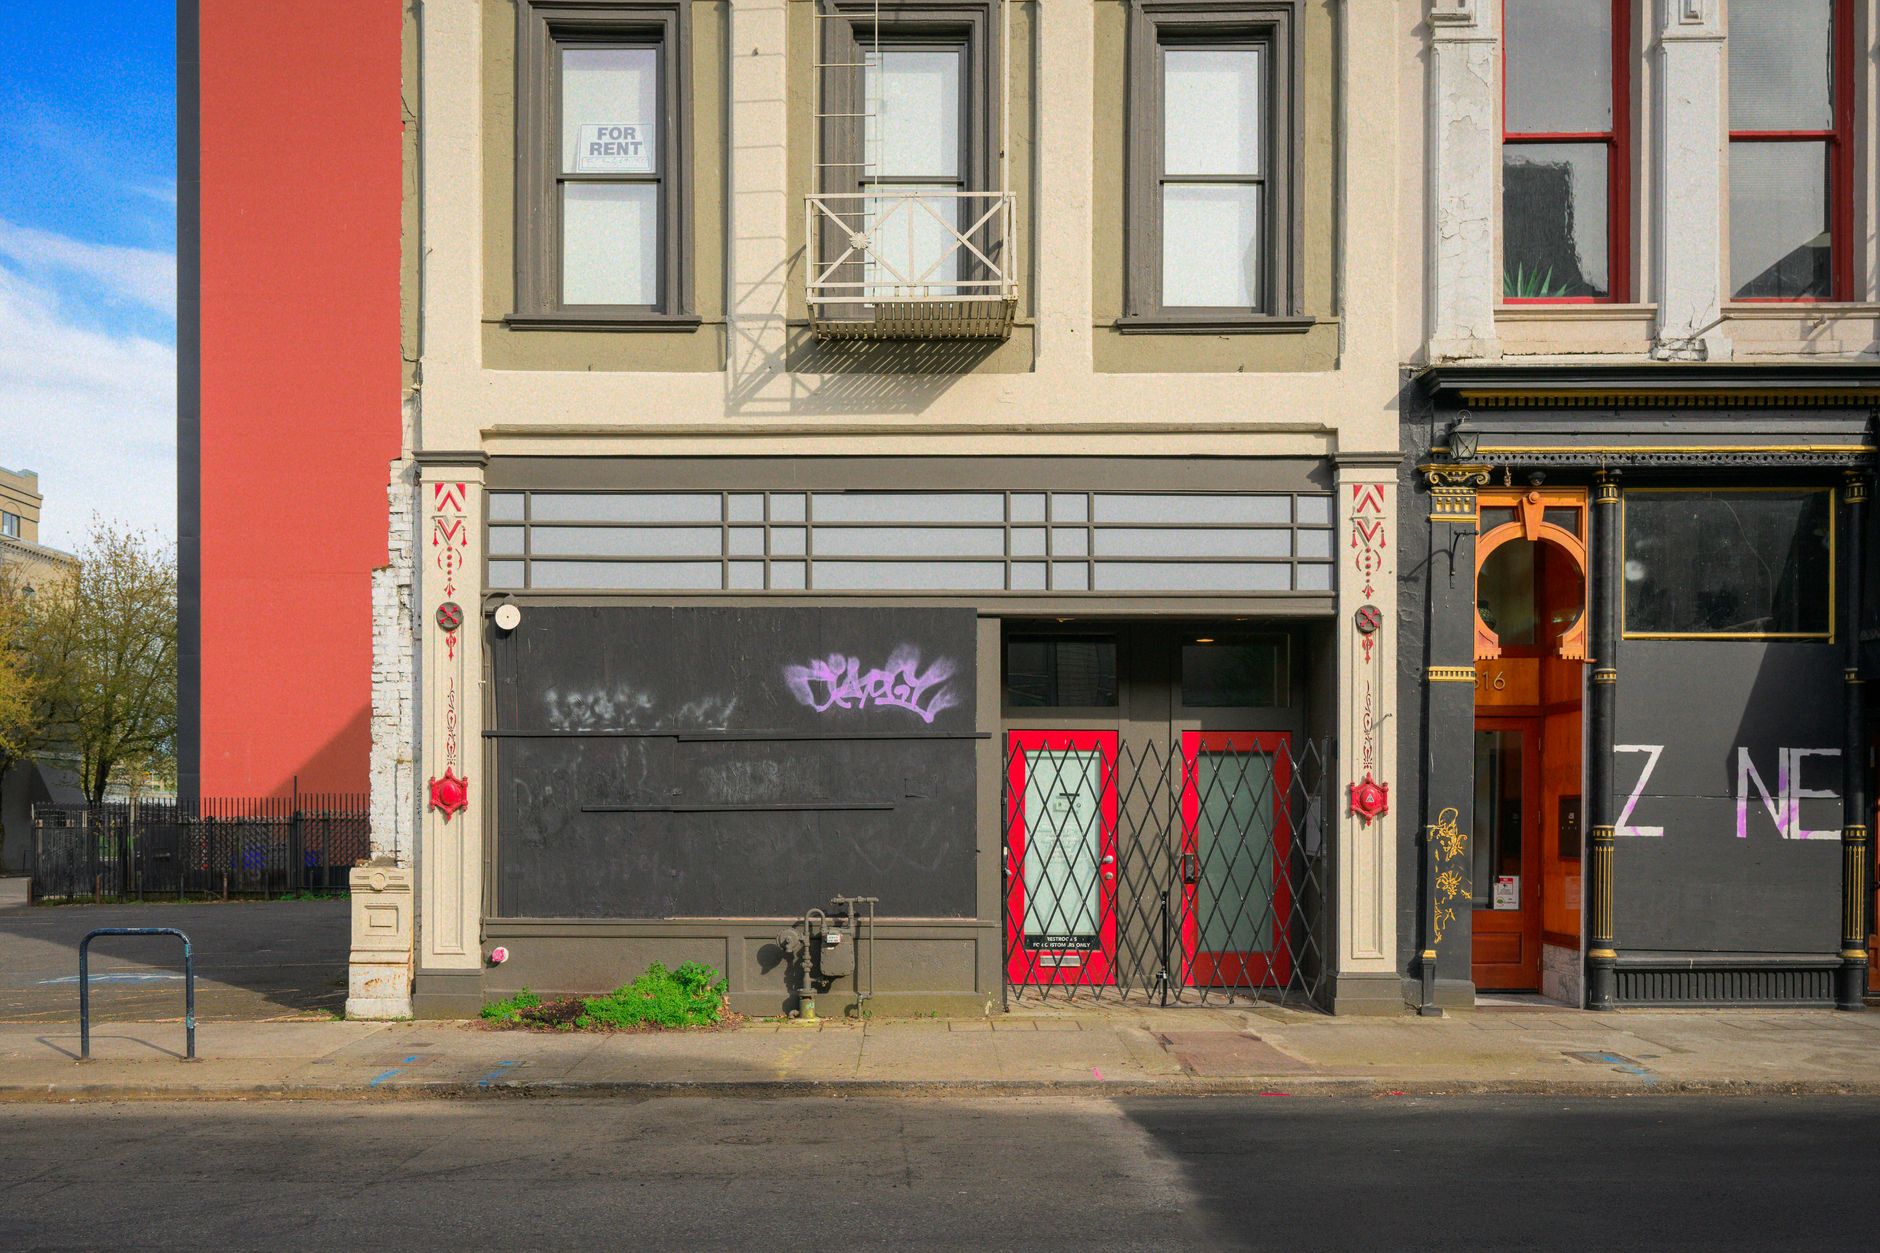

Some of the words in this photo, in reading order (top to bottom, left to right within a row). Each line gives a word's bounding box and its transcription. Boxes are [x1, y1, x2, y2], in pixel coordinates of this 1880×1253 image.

[597, 127, 636, 141] FOR
[589, 142, 642, 156] RENT
[1614, 745, 1664, 836] Z
[1736, 747, 1842, 840] NE
